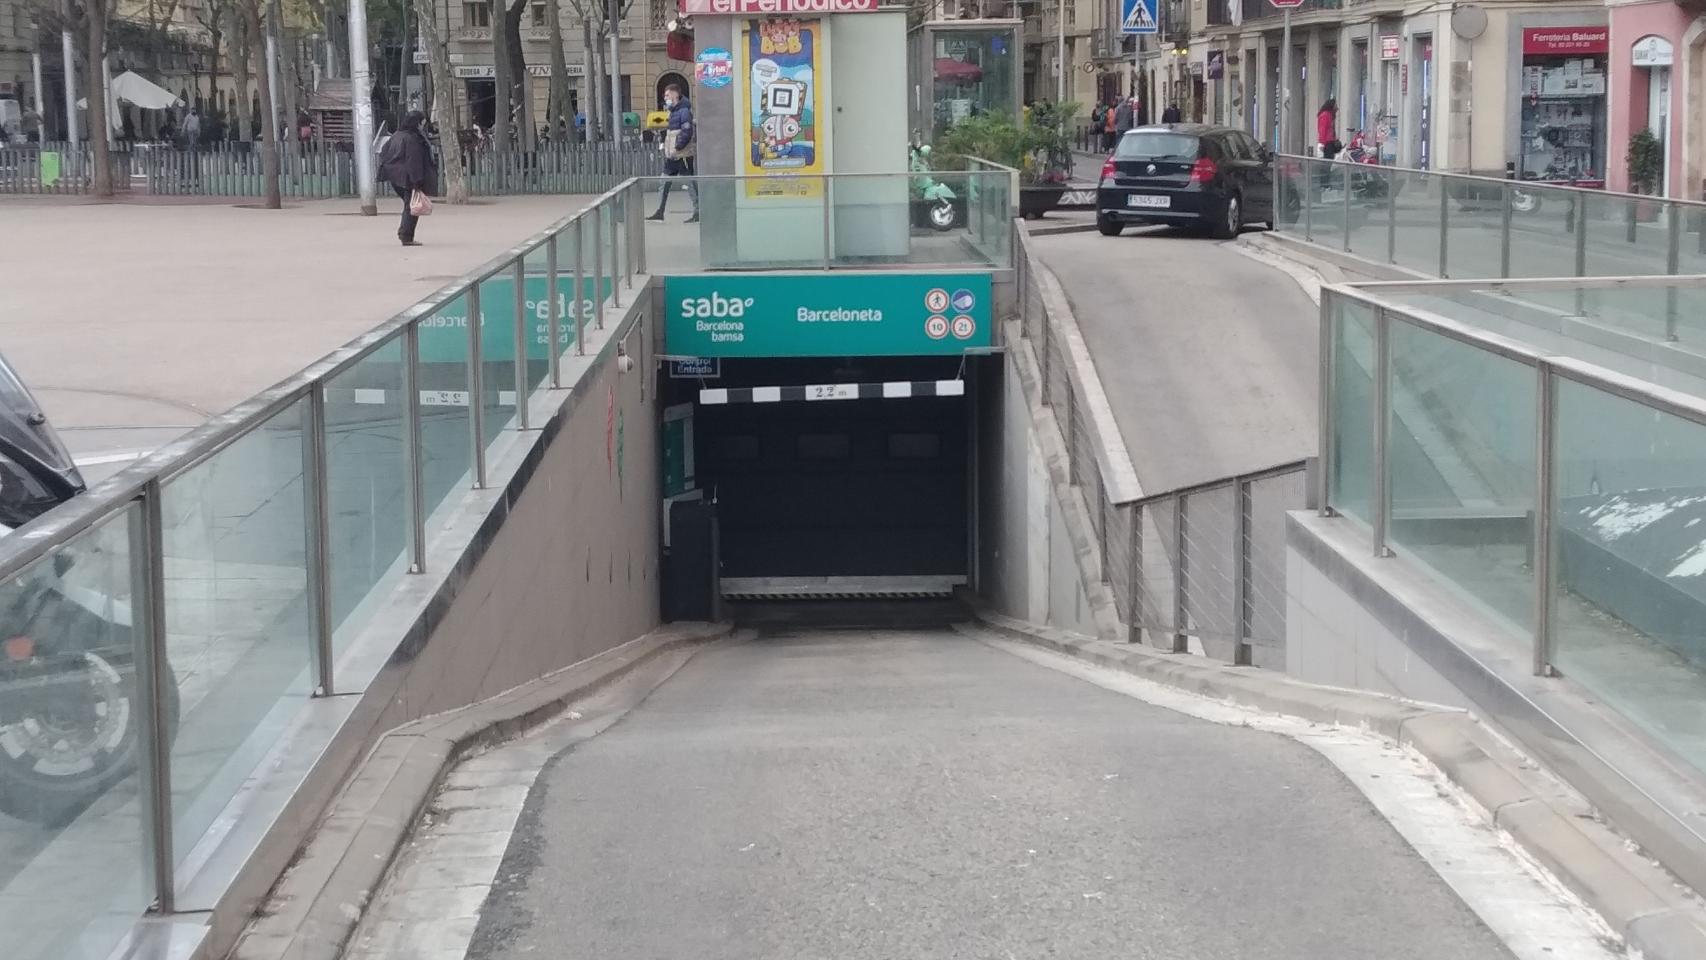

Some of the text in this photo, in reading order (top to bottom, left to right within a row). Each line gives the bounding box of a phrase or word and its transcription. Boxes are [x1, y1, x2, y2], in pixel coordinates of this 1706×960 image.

[1571, 31, 1606, 41] Baluard
[681, 292, 744, 318] saba
[796, 307, 883, 323] Barceloneta
[696, 320, 744, 332] Barcelona
[932, 323, 943, 331] 10
[711, 332, 744, 343] bamsa
